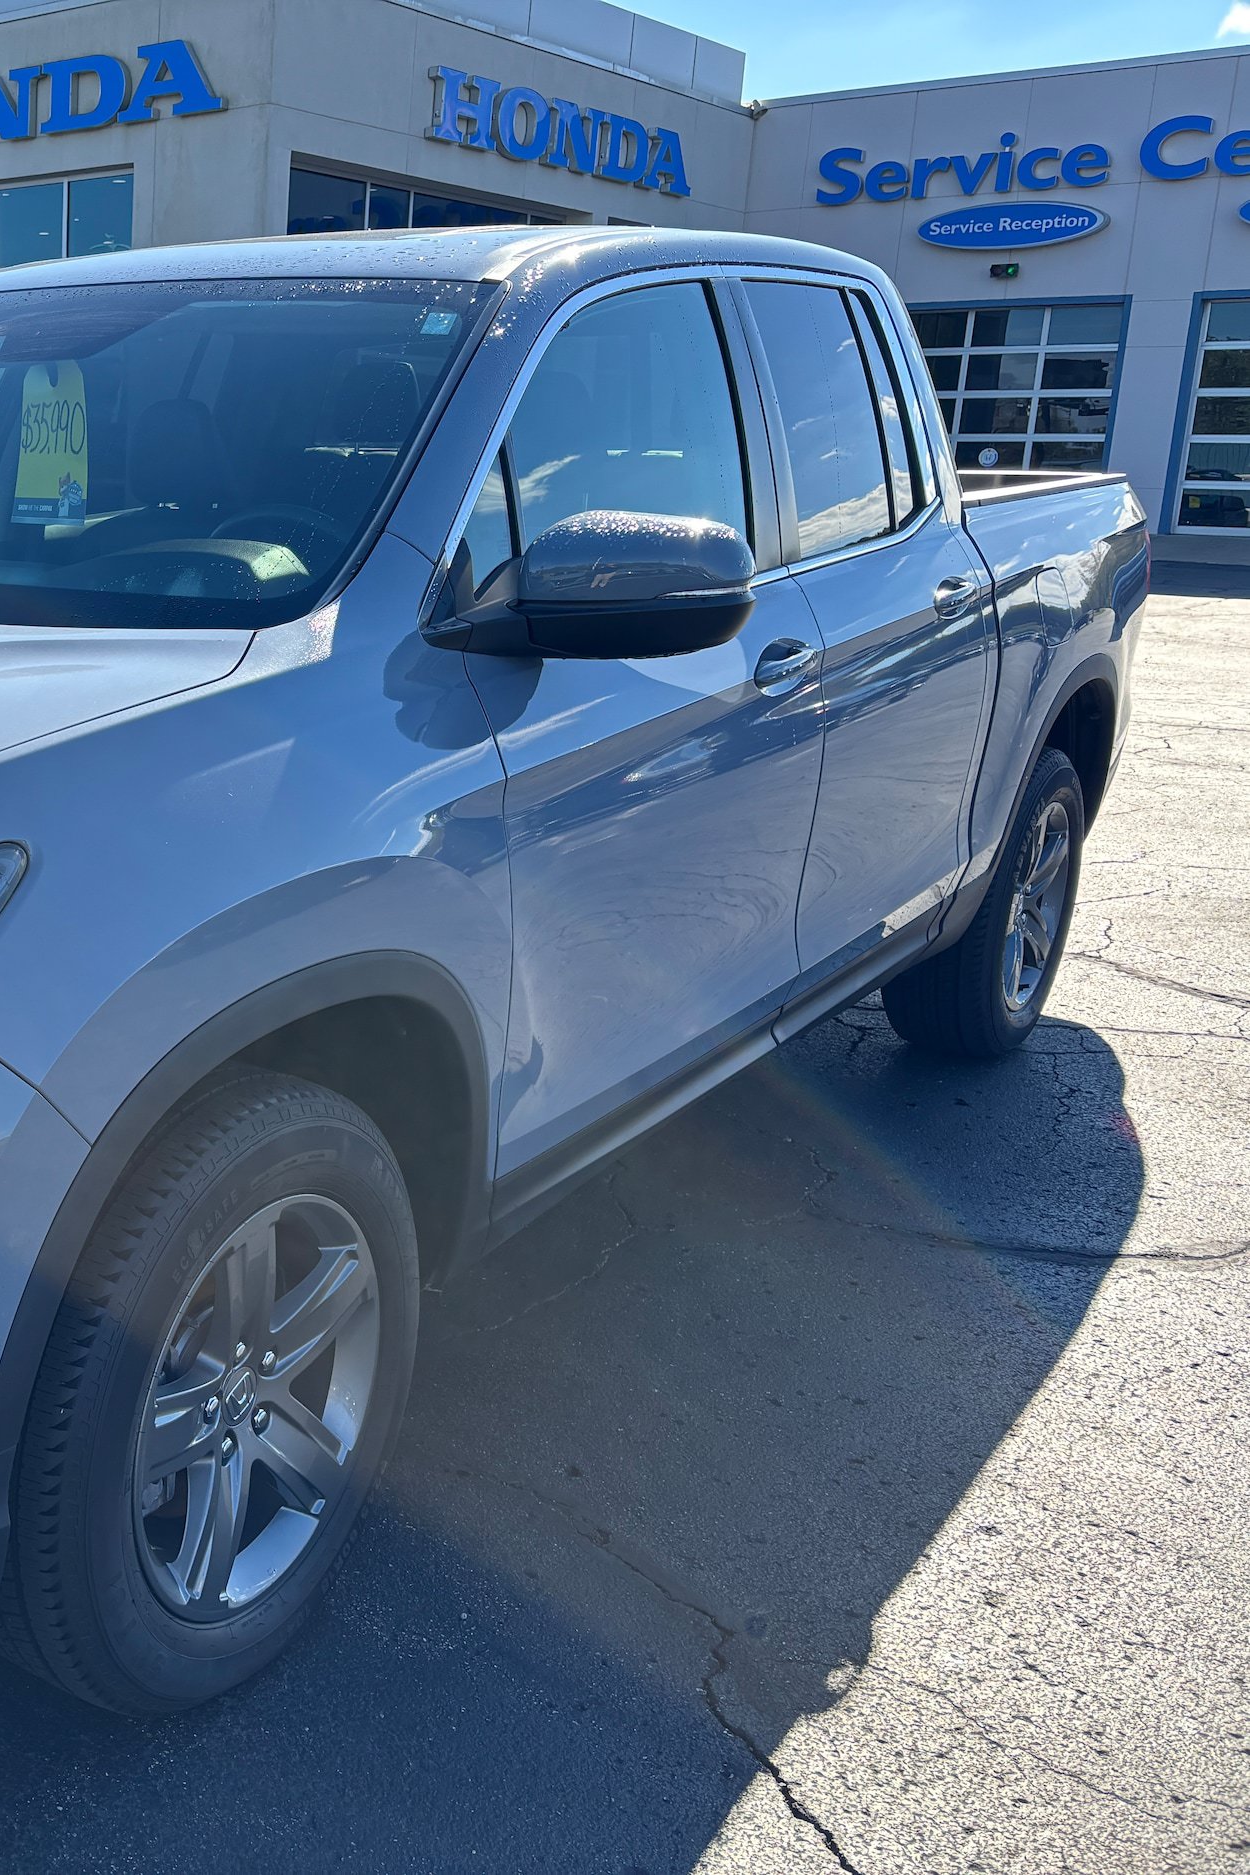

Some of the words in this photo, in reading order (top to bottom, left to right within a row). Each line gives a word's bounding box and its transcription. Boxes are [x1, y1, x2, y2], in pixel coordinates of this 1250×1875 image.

[427, 65, 691, 197] HONDA
[816, 131, 1111, 205] Service
[929, 220, 994, 236] Service
[999, 213, 1090, 232] Reception
[21, 400, 86, 455] $35,990
